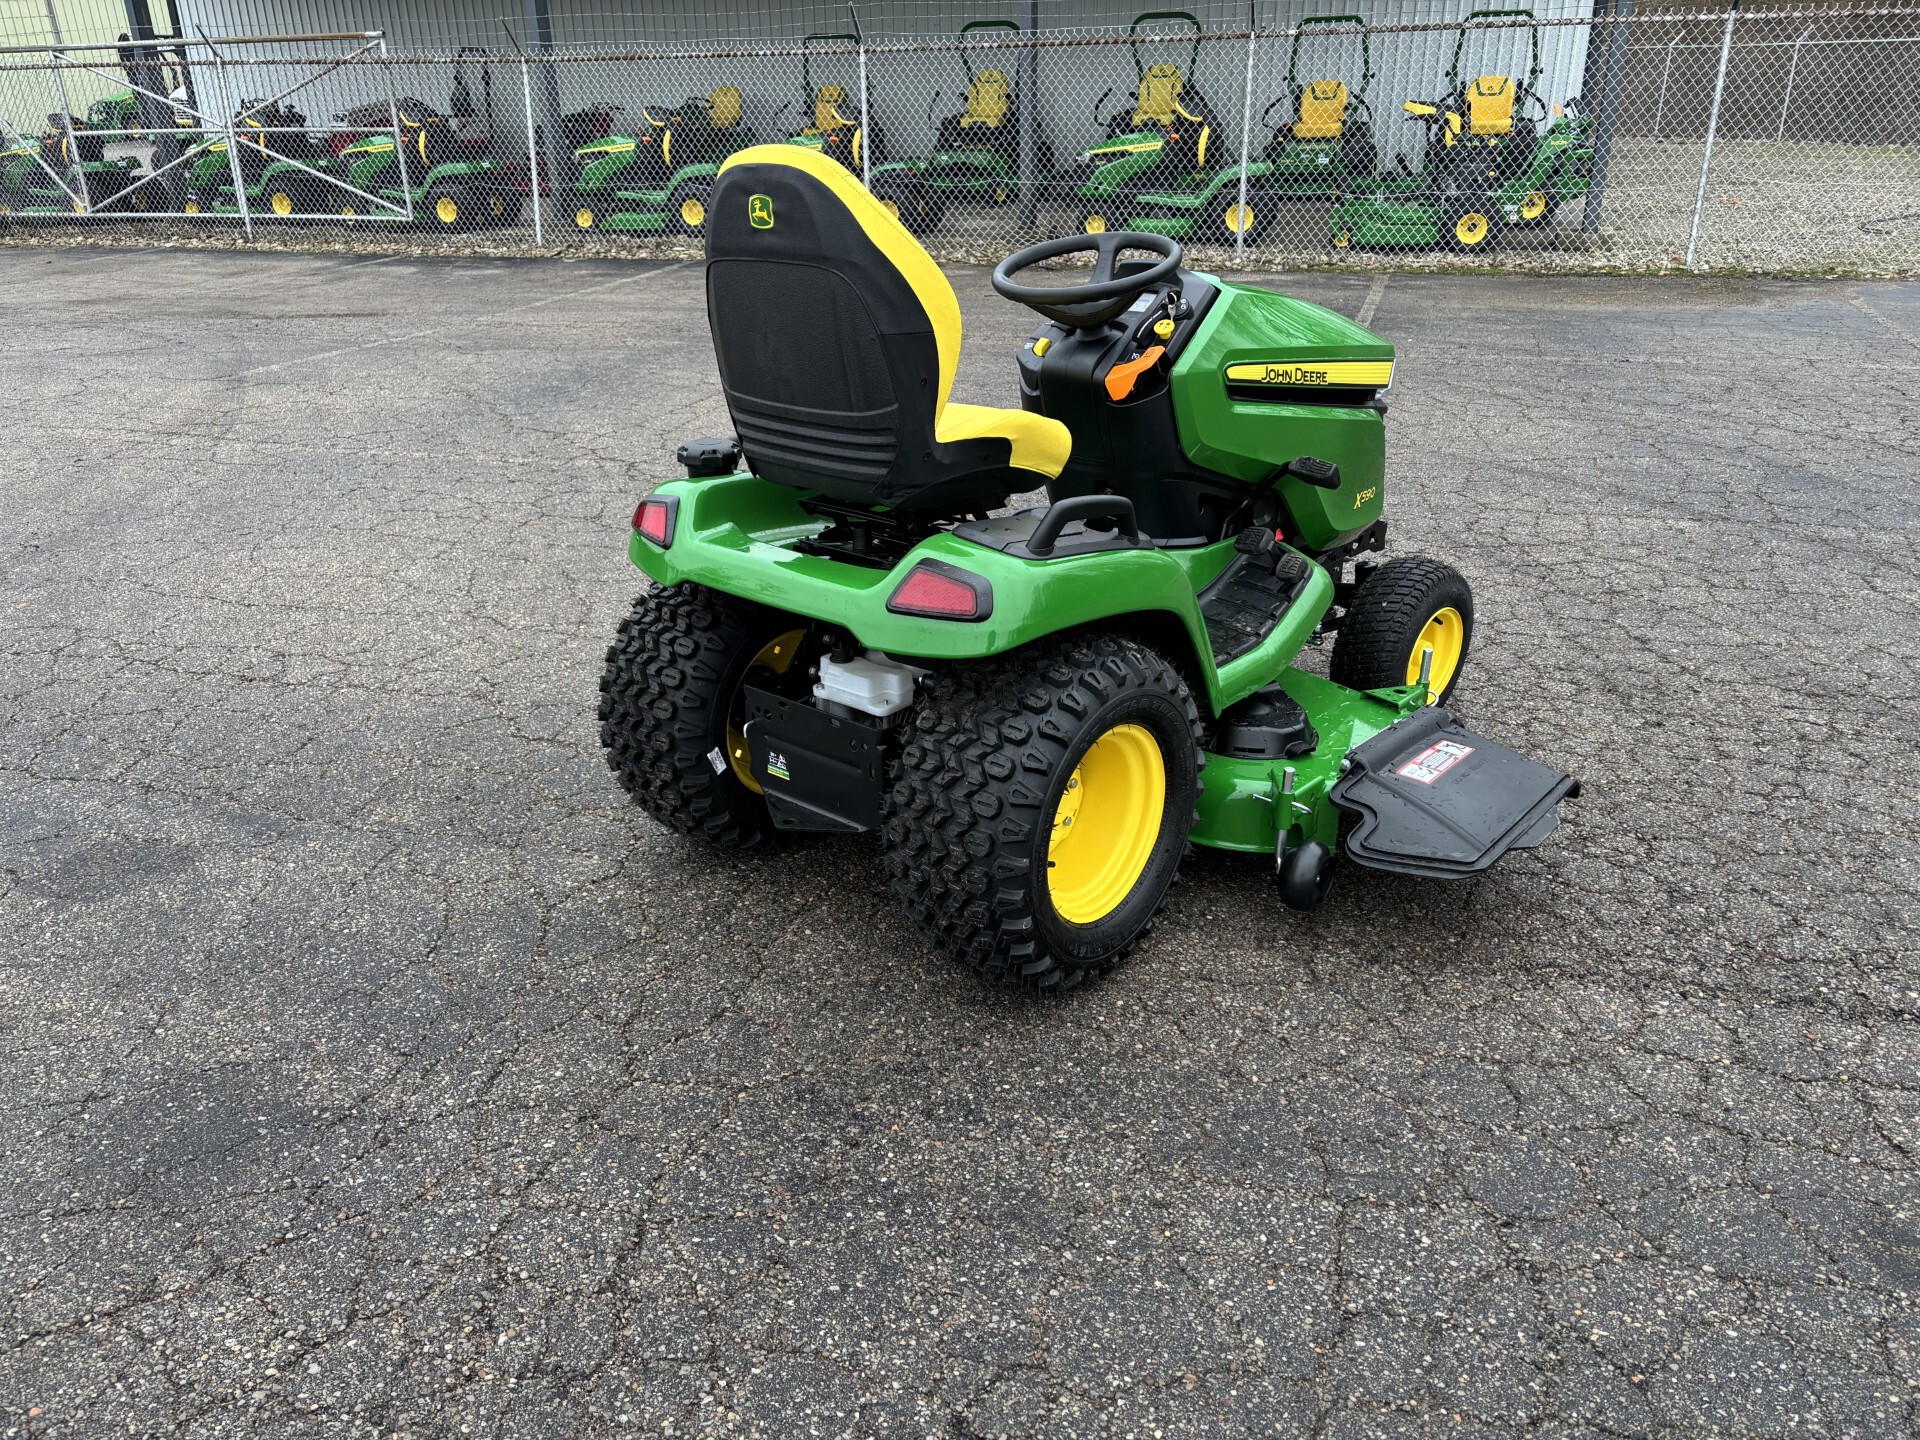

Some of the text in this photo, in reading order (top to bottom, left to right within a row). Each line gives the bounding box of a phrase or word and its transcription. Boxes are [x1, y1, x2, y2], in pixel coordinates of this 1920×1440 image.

[1261, 365, 1328, 383] JOHN DEERE
[1353, 486, 1376, 510] X590
